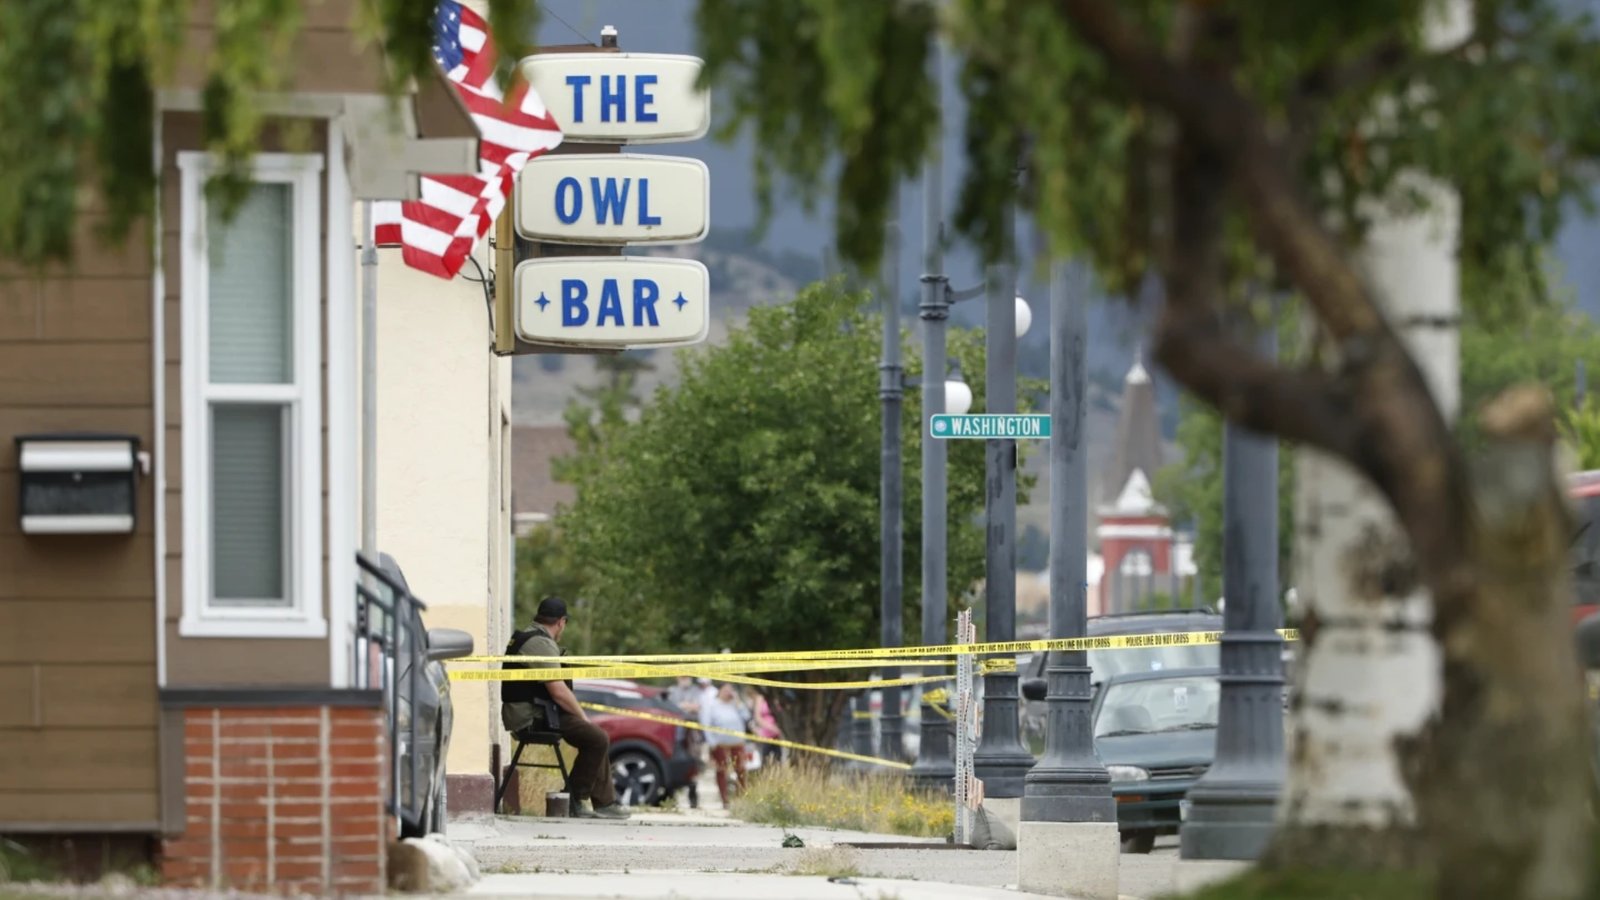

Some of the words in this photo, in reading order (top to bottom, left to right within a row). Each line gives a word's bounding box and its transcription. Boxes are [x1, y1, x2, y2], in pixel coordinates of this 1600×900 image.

[566, 75, 658, 122] THE
[555, 176, 662, 226] OWL
[561, 279, 660, 327] BAR
[951, 417, 1040, 435] WASHINGTON
[1047, 640, 1063, 650] POLICE
[1064, 640, 1075, 649] LINE
[1076, 640, 1083, 649] DO
[1084, 639, 1094, 649] NOT
[1094, 637, 1111, 648] CROSS
[1126, 636, 1142, 647] POLICE
[1143, 635, 1154, 646] LINE
[1155, 635, 1162, 645] DO
[1163, 634, 1172, 645] NOT
[1173, 633, 1190, 644] CROSS
